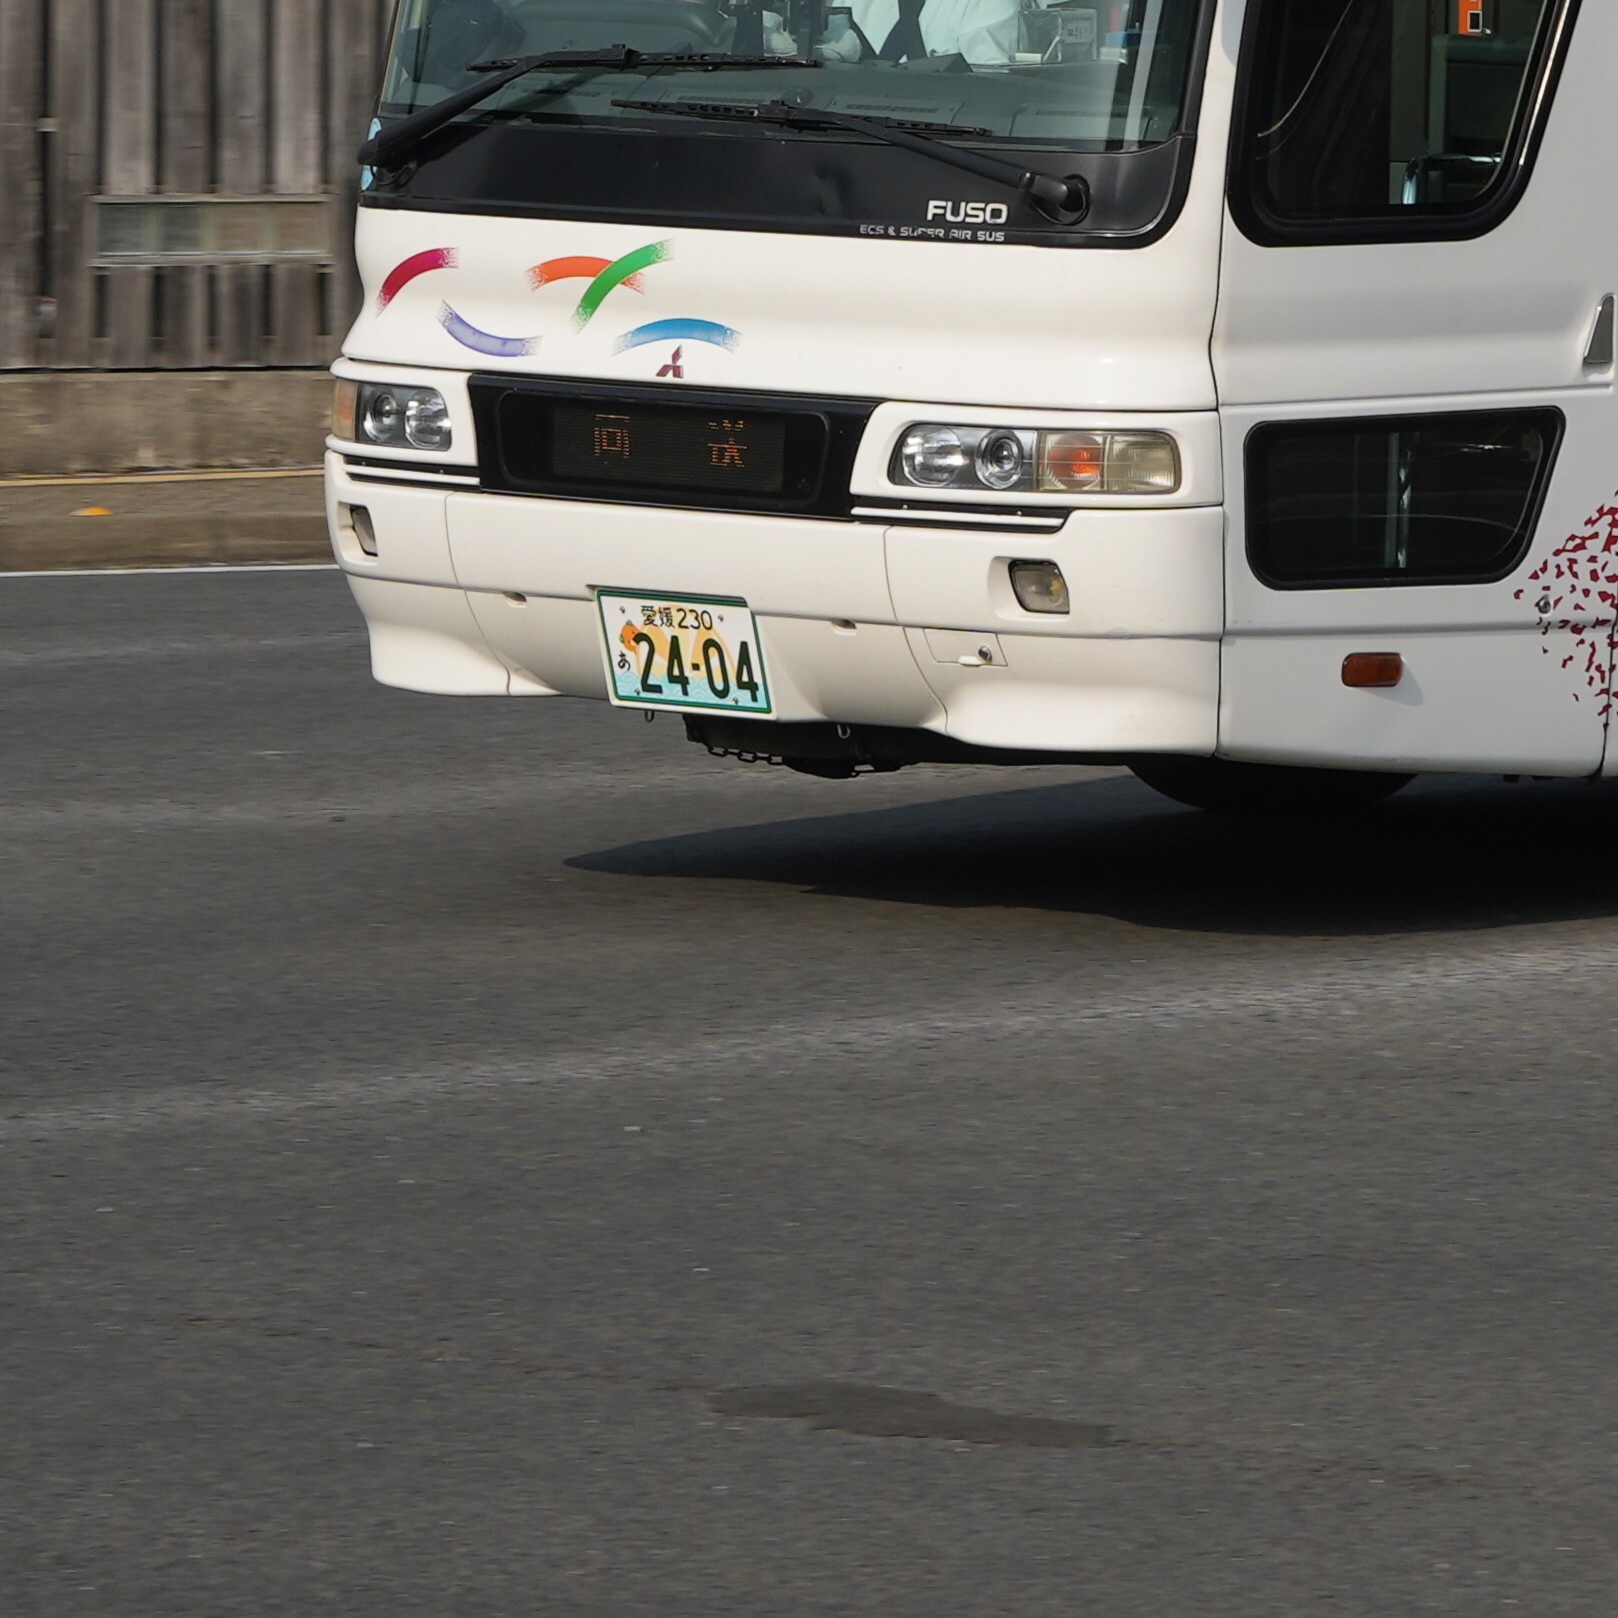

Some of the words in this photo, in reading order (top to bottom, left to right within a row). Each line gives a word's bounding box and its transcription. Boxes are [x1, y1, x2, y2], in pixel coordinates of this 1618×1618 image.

[926, 199, 1009, 225] FUSO
[859, 224, 885, 235] ECS
[886, 226, 897, 236] &
[949, 229, 972, 241] AIR
[976, 231, 1006, 242] SUS
[617, 650, 631, 672] あ
[632, 631, 760, 703] 24-04
